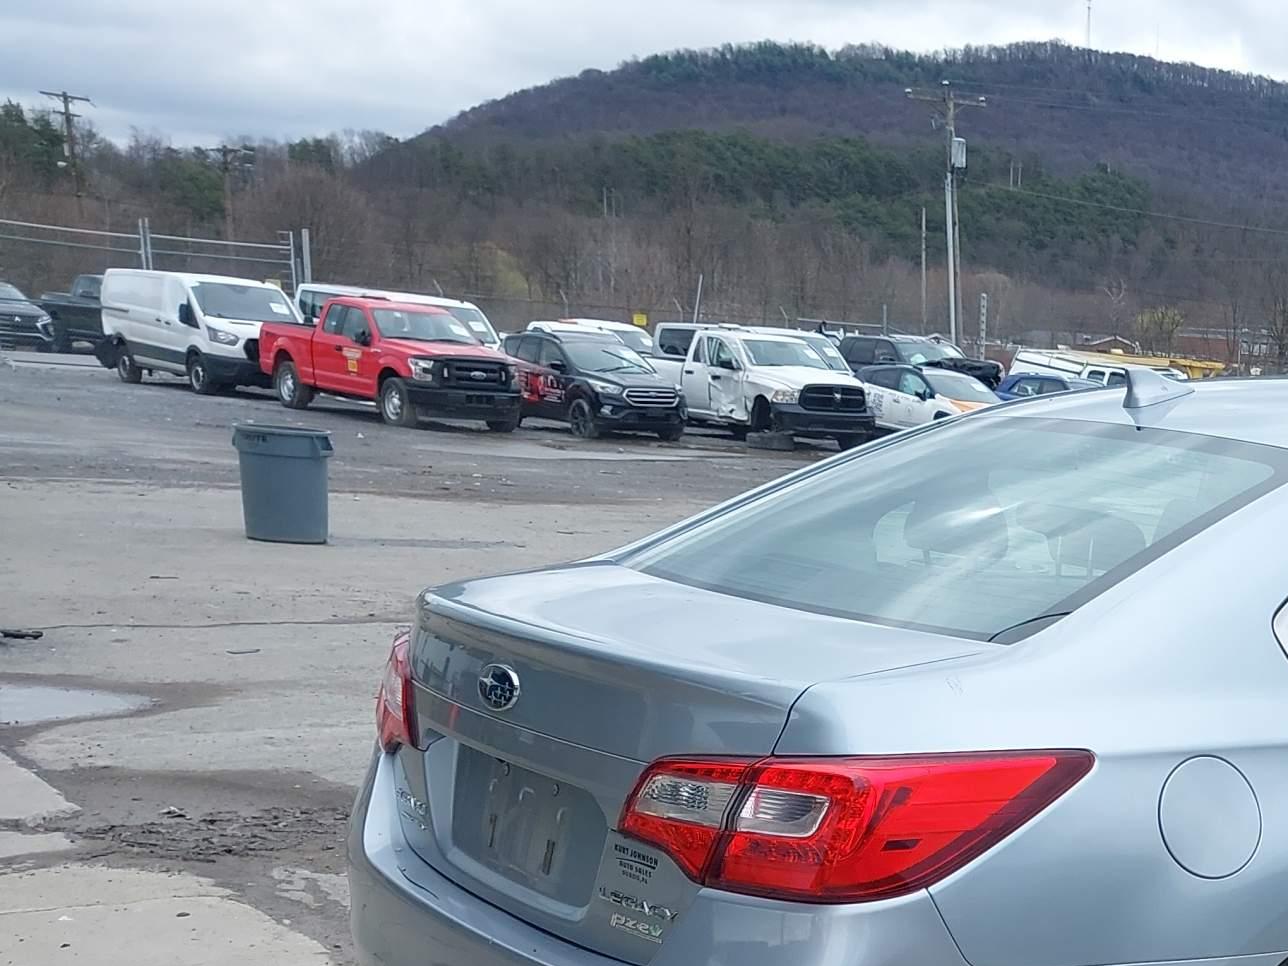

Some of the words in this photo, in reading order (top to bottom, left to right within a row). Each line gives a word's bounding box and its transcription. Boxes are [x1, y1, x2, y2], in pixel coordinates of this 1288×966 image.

[614, 843, 629, 855] KURT
[630, 848, 659, 867] JOHNSON
[618, 860, 634, 871] AUTO
[599, 887, 679, 920] LEGACY
